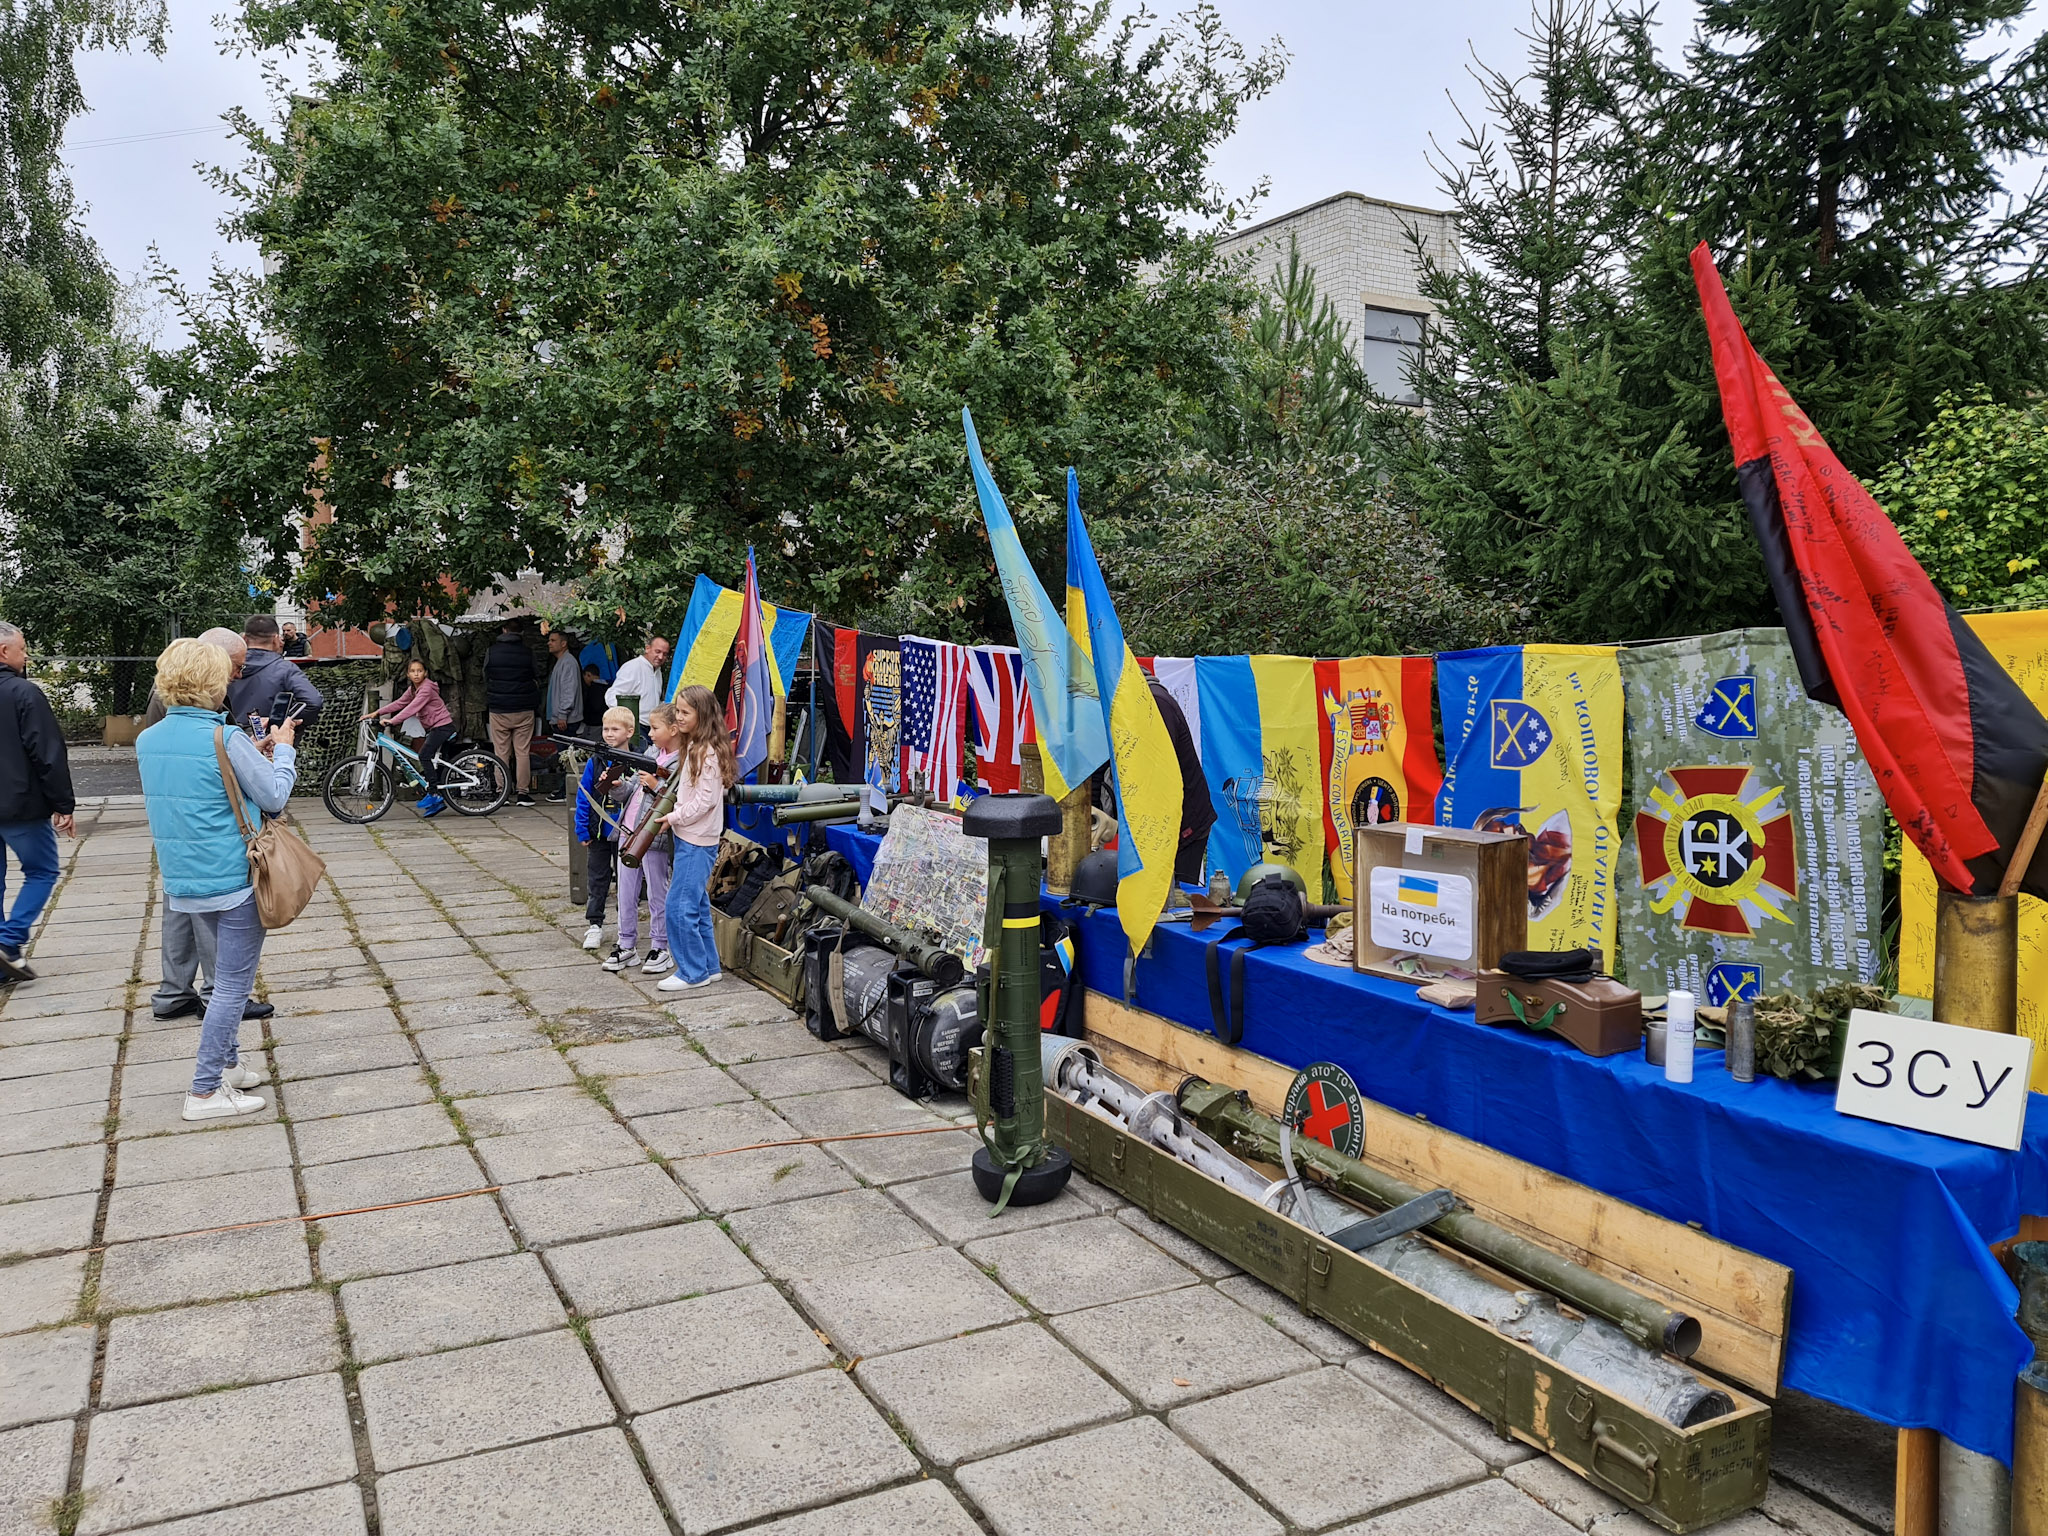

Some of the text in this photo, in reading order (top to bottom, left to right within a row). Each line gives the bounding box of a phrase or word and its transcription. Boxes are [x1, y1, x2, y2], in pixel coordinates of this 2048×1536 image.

[873, 649, 901, 662] SUPPOR
[873, 673, 902, 687] FREEDO
[1684, 687, 1697, 726] ОПЕРАТ
[1333, 729, 1349, 781] ESTAMOS
[1331, 784, 1342, 804] CON
[1390, 793, 1399, 822] ДОПОМО
[1842, 761, 1859, 821] окрема
[1798, 760, 1820, 877] механізований
[1820, 744, 1849, 970] імені Гетьмана Івана Мазепи
[1846, 823, 1868, 933] механізована
[1381, 902, 1456, 927] На потреби
[1808, 883, 1824, 967] батальйон
[1402, 929, 1433, 948] ЗСУ
[1856, 938, 1871, 983] брига
[1678, 958, 1689, 992] COMM
[1689, 953, 1701, 1010] OPERATION
[1852, 1040, 2014, 1109] ЗСУ
